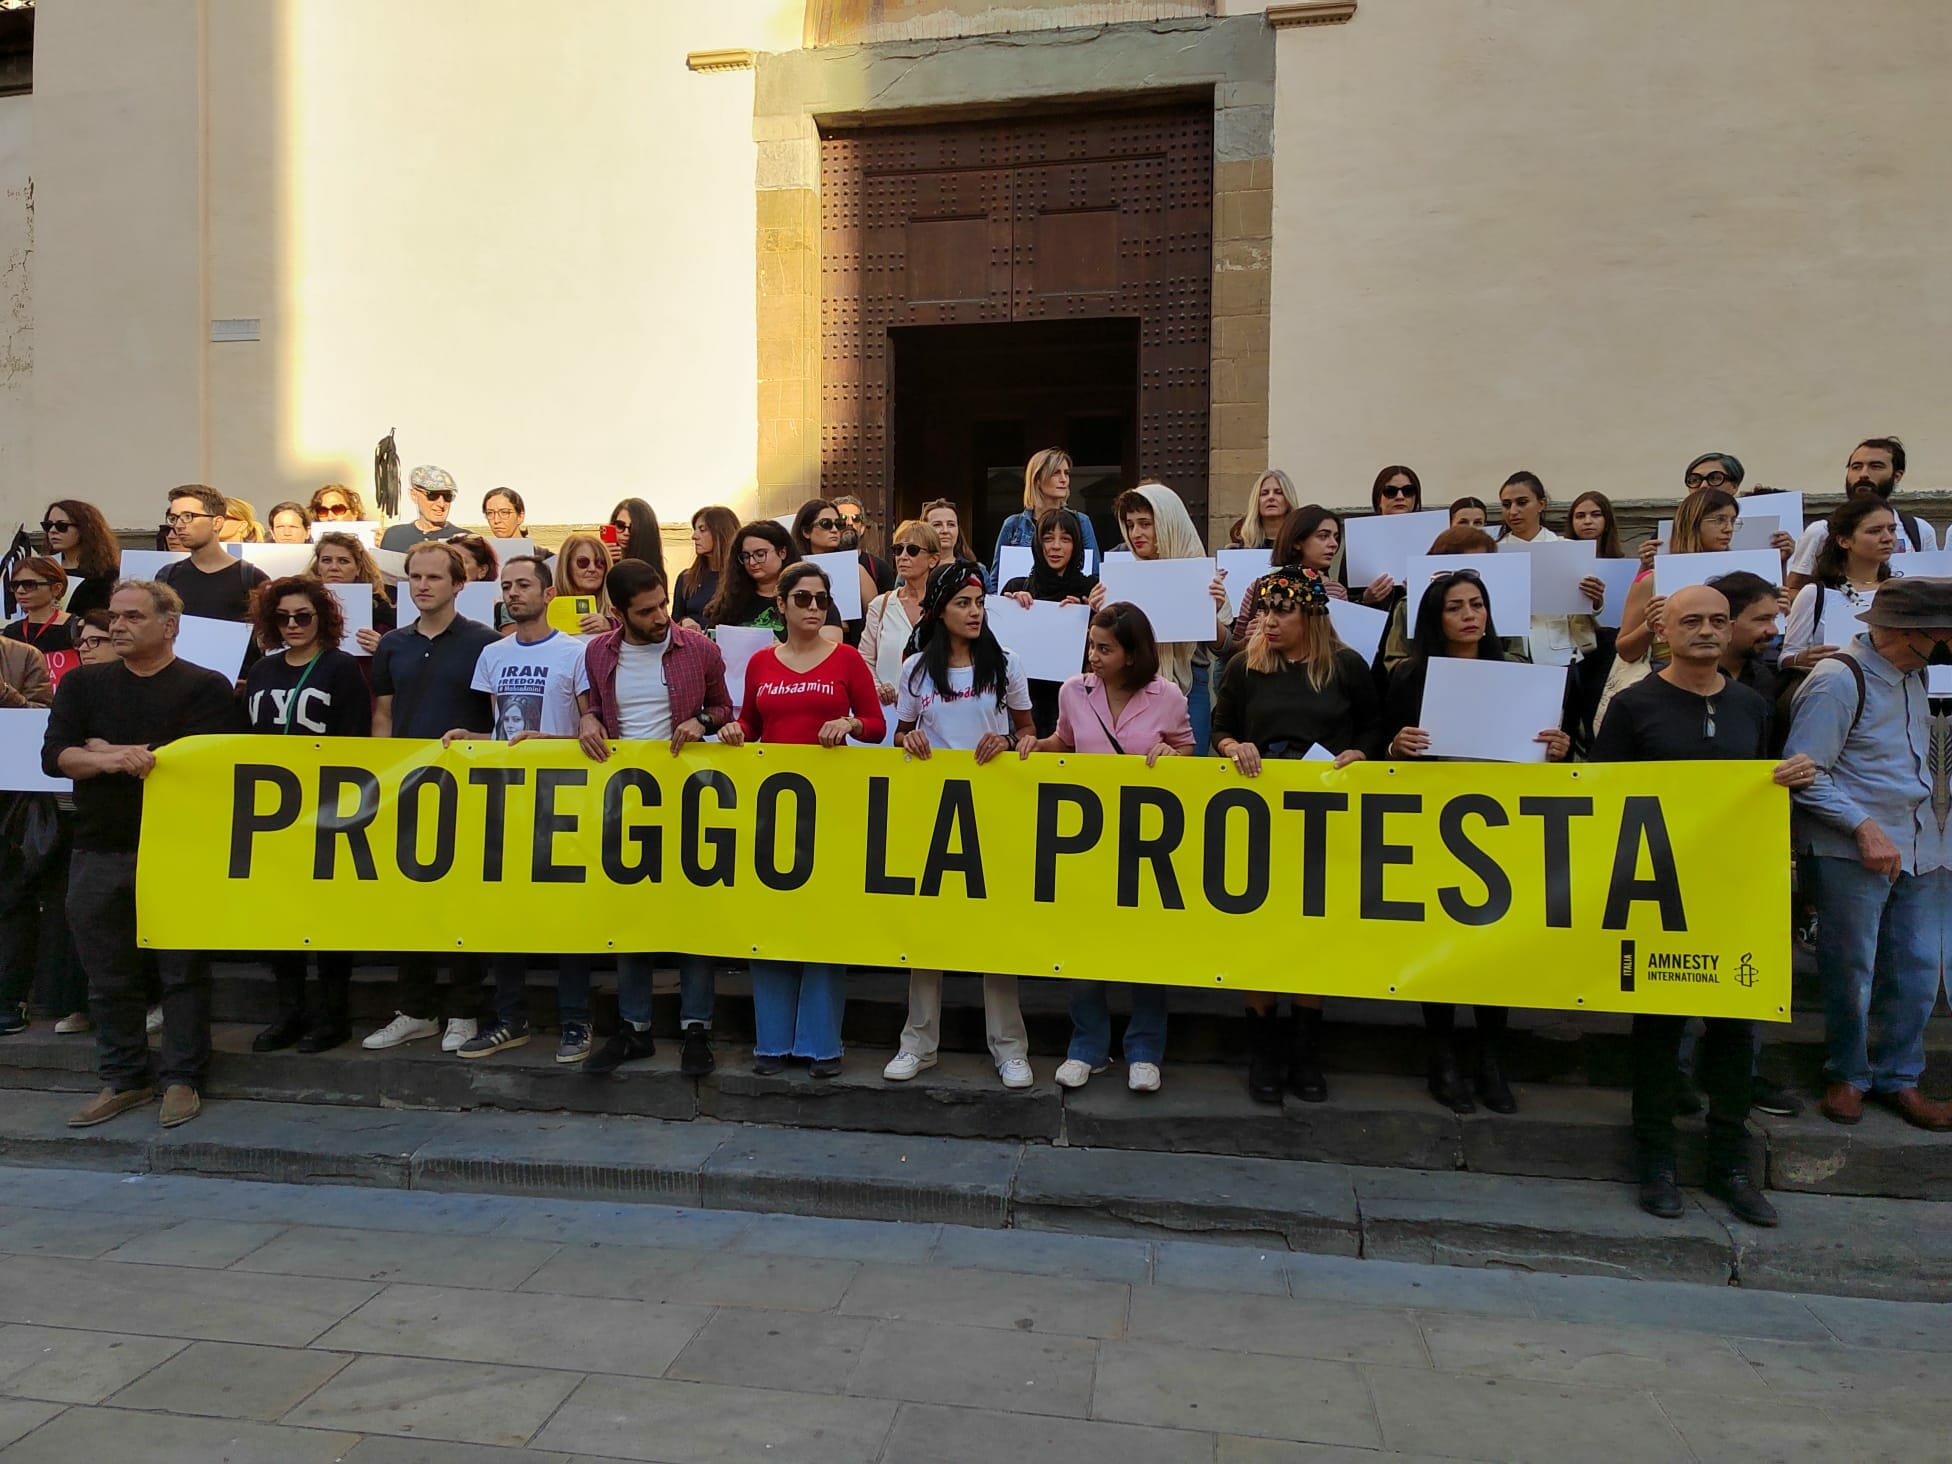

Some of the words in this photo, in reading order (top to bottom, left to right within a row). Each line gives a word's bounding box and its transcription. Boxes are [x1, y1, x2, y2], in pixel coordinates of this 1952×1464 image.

[501, 665, 549, 678] IRAN
[498, 678, 546, 686] FREEDOM
[229, 763, 816, 892] PROTEGGO
[864, 776, 987, 900] LA
[1033, 782, 1689, 932] PROTESTA
[1623, 954, 1633, 976] ITALIA
[1648, 952, 1719, 971] AMNESTY
[1648, 970, 1720, 984] INTERNATIONAL
